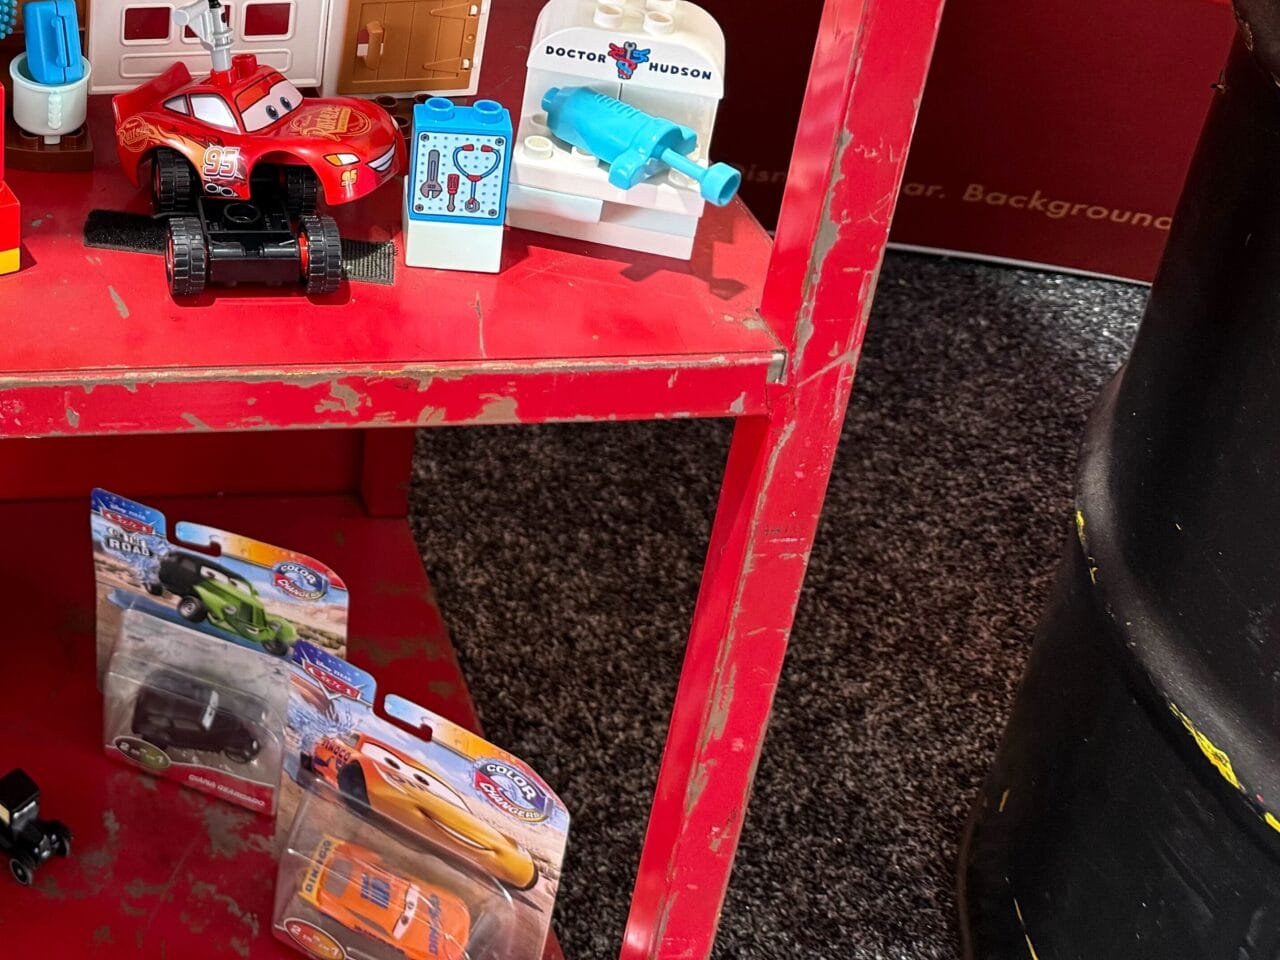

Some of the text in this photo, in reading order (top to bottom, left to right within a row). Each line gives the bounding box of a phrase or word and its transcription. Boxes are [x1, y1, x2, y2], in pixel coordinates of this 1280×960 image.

[545, 45, 712, 80] DOCTOR HUDSON
[203, 146, 240, 178] 95
[340, 170, 358, 187] 95
[109, 538, 150, 556] ROAD
[280, 563, 317, 584] COLOR
[486, 763, 536, 800] COLOR
[479, 781, 543, 819] CHANGERS
